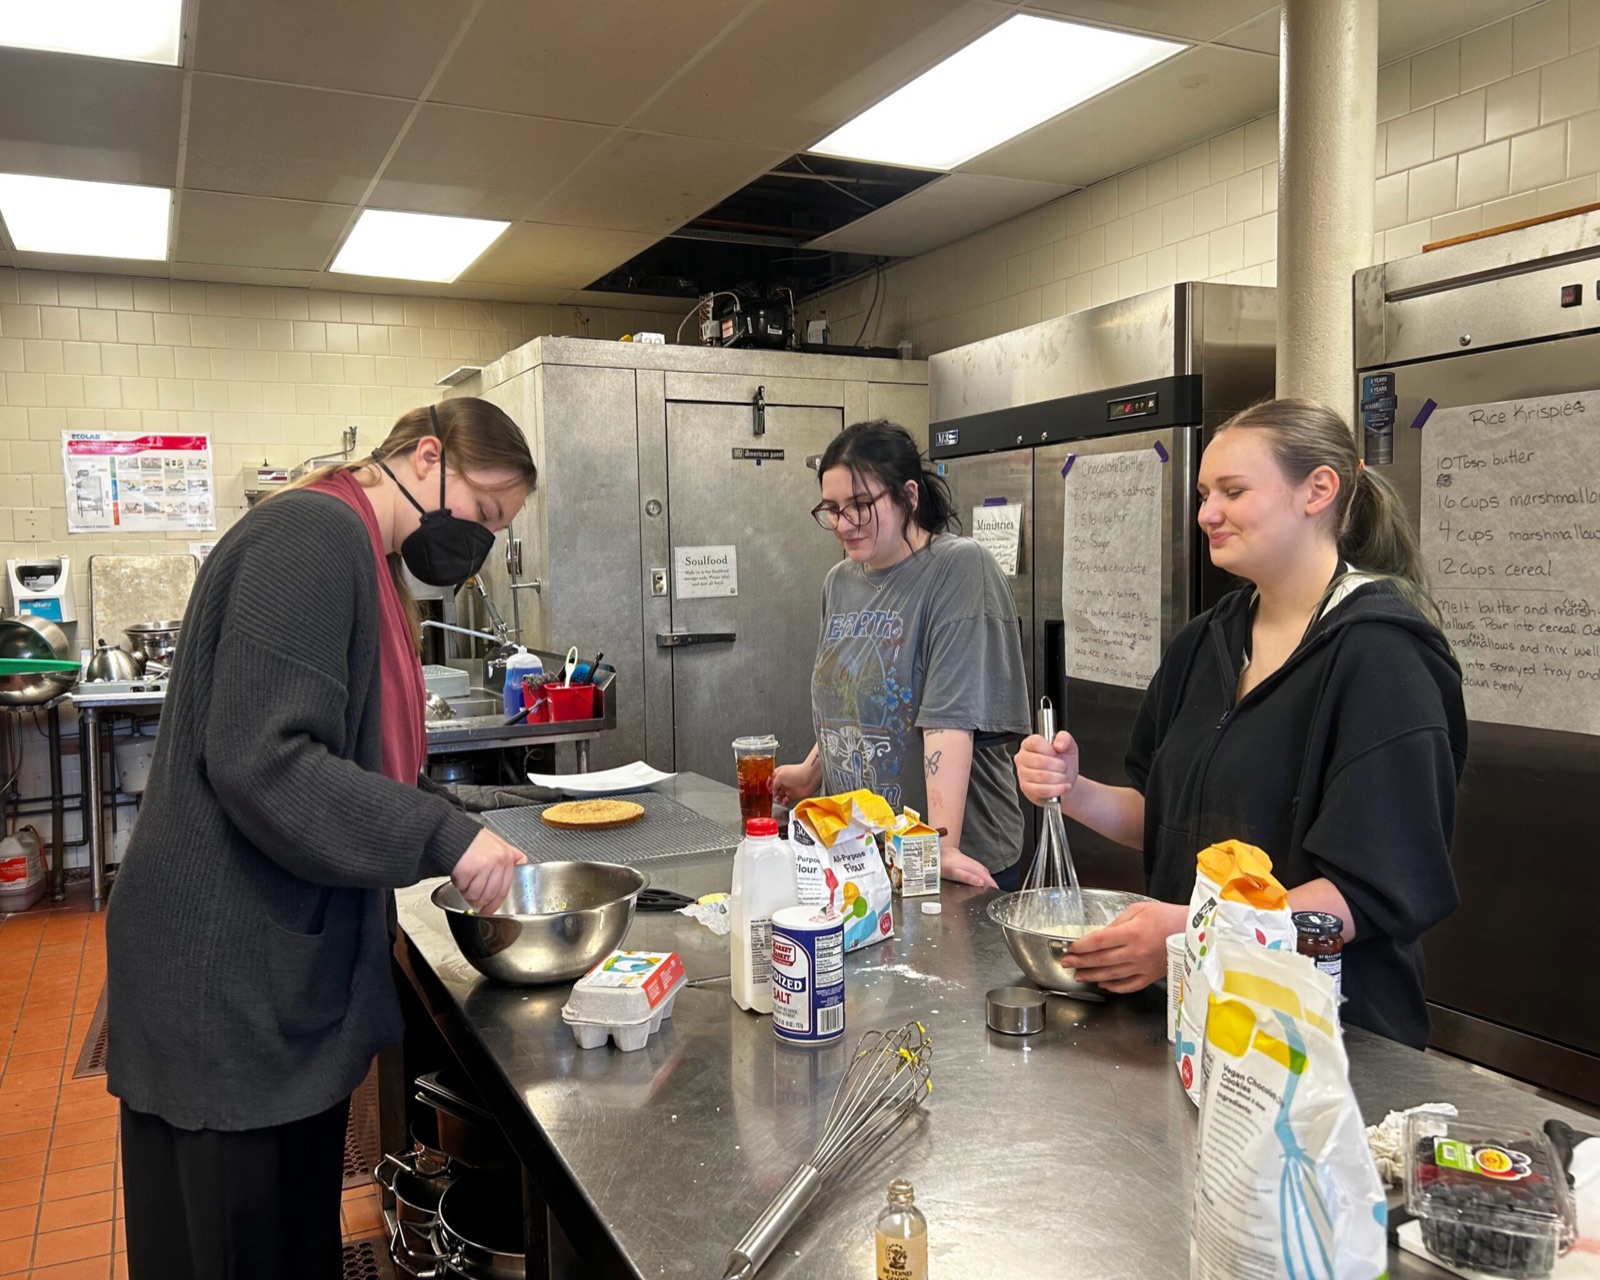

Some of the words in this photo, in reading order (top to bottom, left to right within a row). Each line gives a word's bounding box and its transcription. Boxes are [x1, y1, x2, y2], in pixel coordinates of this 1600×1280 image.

[1364, 401, 1393, 411] WARRANTY
[1469, 409, 1506, 427] Rice
[1514, 400, 1586, 424] Krispies
[1492, 449, 1536, 467] butter
[1437, 494, 1456, 509] 16
[976, 519, 1014, 531] Ministries
[1438, 520, 1451, 542] 4
[685, 555, 728, 566] Soulfood
[1438, 557, 1456, 576] 12
[1504, 559, 1553, 578] cereal
[1437, 600, 1472, 614] Melt
[1477, 599, 1521, 615] butter
[1523, 602, 1548, 616] and
[1480, 616, 1509, 631] Pour
[1513, 619, 1535, 632] into
[1451, 637, 1515, 651] arshmallows
[1519, 643, 1540, 655] and
[1544, 644, 1568, 656] mix
[1465, 658, 1486, 671] into
[1489, 661, 1536, 678] sprayed
[1542, 661, 1573, 683] tray
[832, 851, 866, 864] All-Purpose
[843, 862, 866, 874] Flour
[772, 987, 792, 1005] SALT
[1223, 1062, 1246, 1082] Vegan
[1221, 1072, 1252, 1095] Cookies
[882, 1266, 913, 1277] BEYOND
